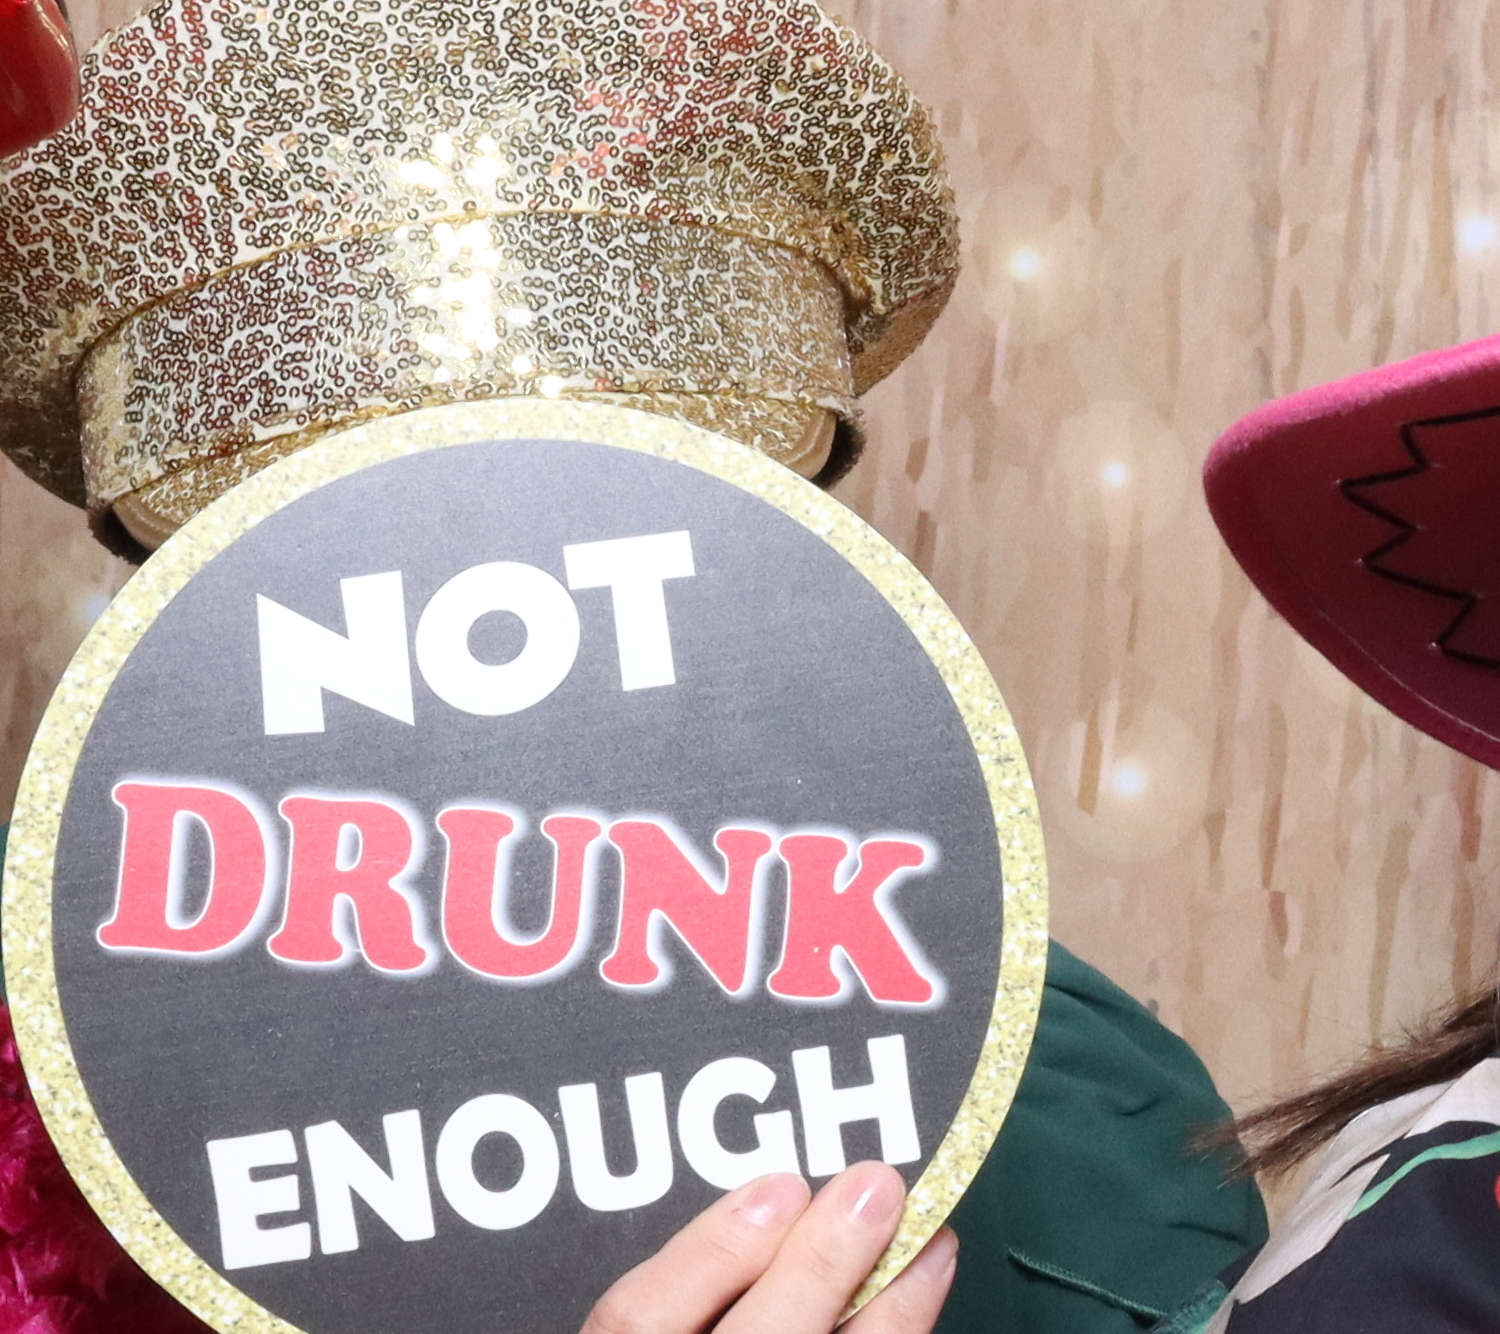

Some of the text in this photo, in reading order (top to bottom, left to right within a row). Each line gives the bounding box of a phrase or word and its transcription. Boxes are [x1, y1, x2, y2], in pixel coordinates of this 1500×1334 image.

[256, 530, 697, 735] NOT
[96, 778, 947, 1007] DRUNK
[206, 1033, 922, 1270] ENOUGH
